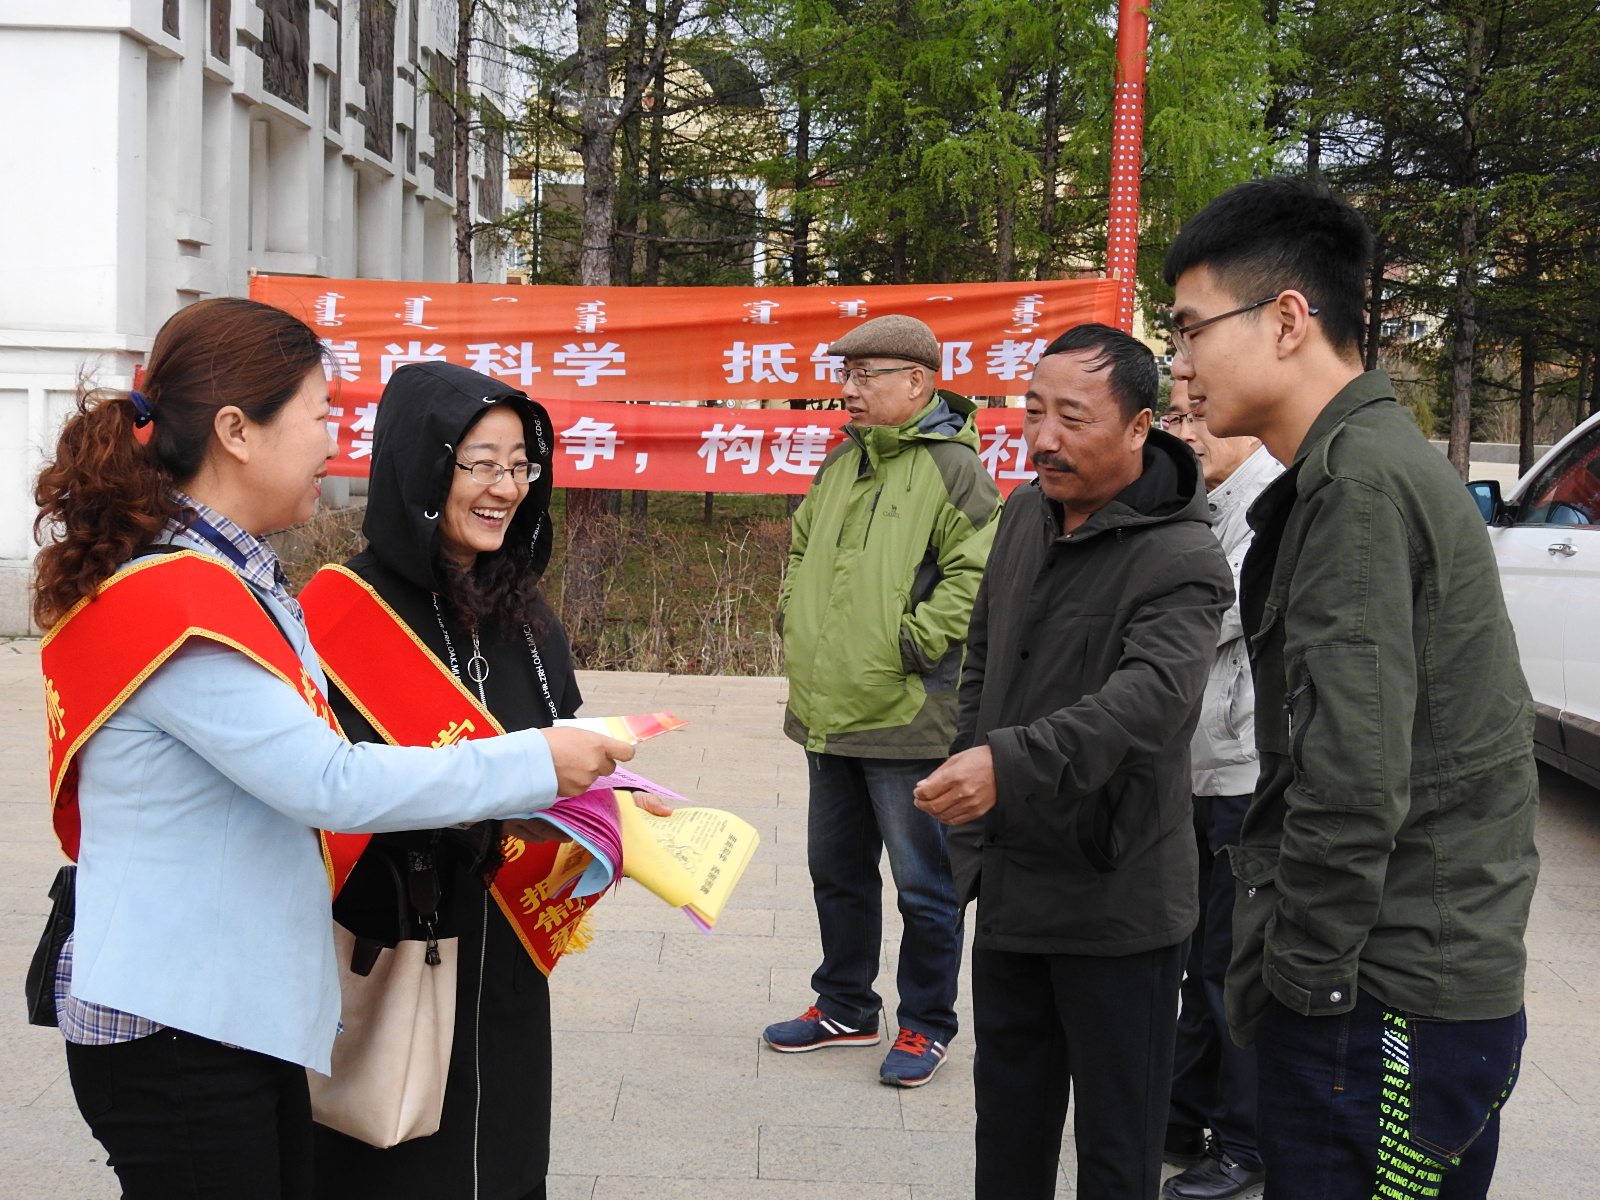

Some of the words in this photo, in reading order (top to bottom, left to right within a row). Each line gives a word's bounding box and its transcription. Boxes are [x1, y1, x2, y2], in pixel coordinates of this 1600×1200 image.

[1396, 1144, 1425, 1163] KUNG
[1390, 1157, 1416, 1175] KUNG
[1385, 1170, 1409, 1187] KUNG
